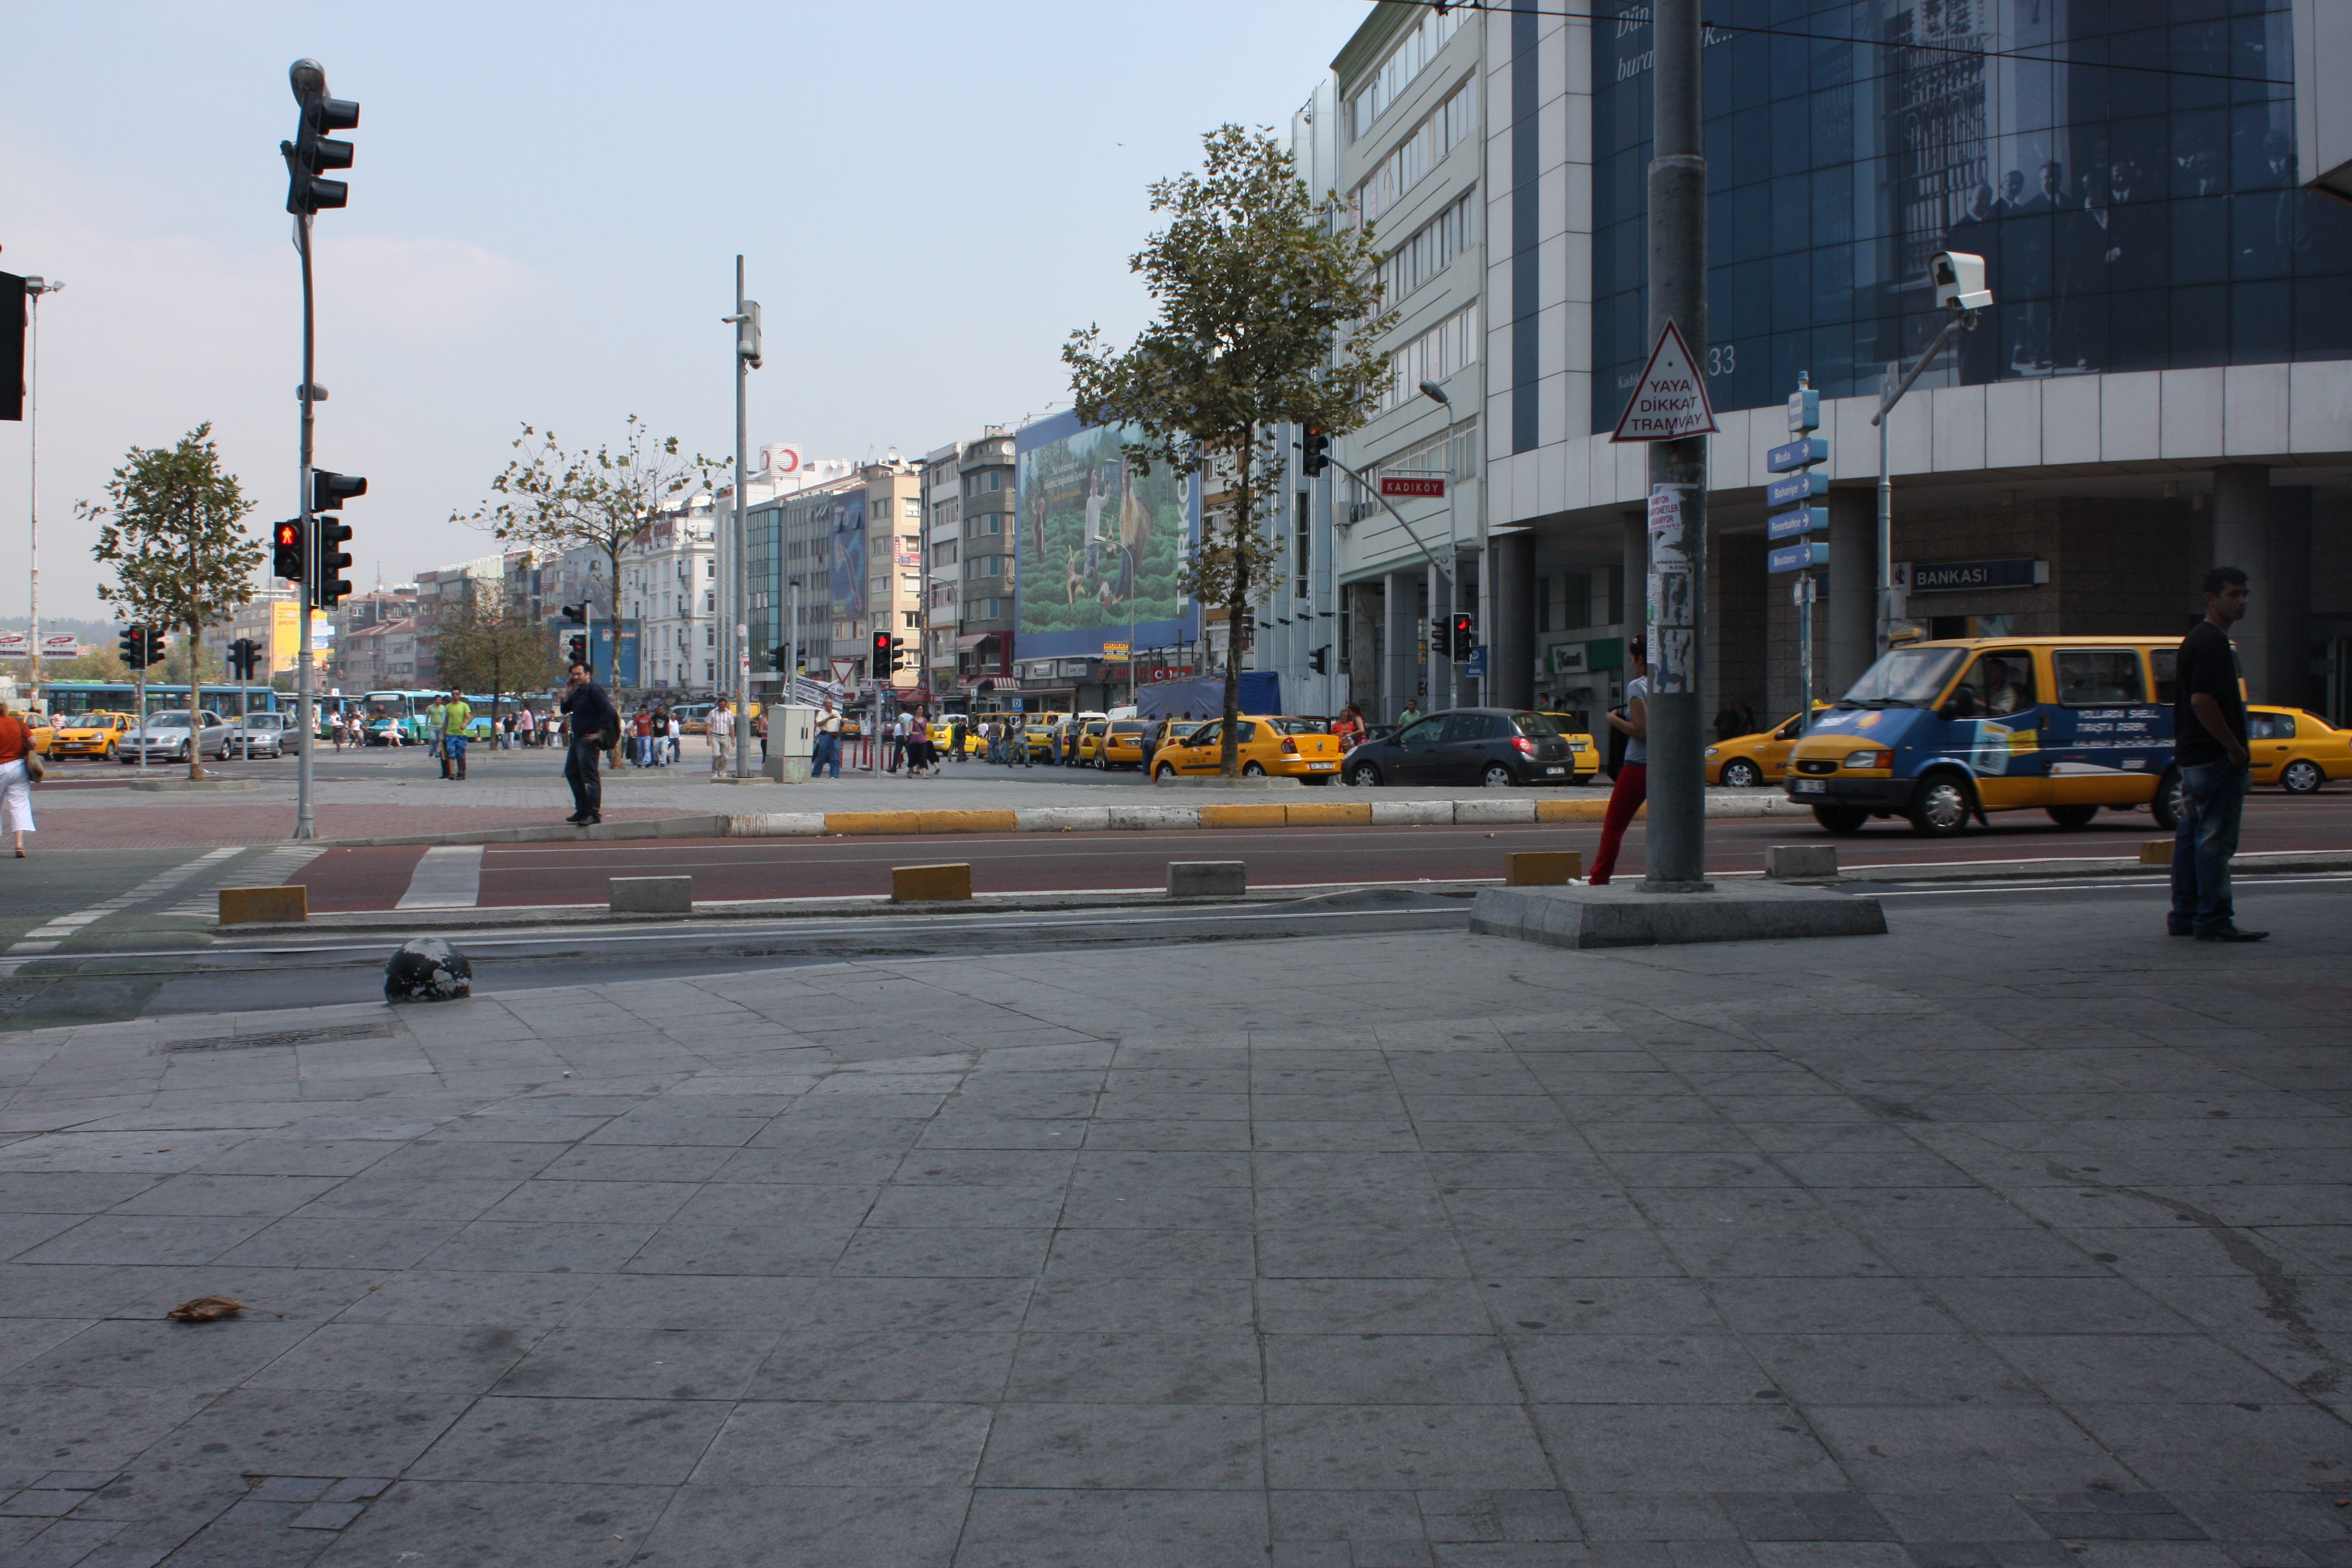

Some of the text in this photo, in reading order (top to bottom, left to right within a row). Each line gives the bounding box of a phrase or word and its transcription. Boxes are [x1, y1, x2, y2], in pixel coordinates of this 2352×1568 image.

[1618, 49, 1653, 81] bura
[1618, 372, 1643, 389] Kadık
[1650, 379, 1690, 393] YAYA
[1641, 396, 1697, 412] DİKKAT
[1631, 412, 1702, 431] TRAMVAY
[1775, 450, 1790, 464] Moda
[1387, 482, 1439, 492] KADIKÖY
[1774, 484, 1798, 498] Bahariye
[1772, 518, 1800, 532] Fenerbahçe
[1774, 555, 1796, 567] Bostancı
[1917, 568, 1988, 585] BANKASI
